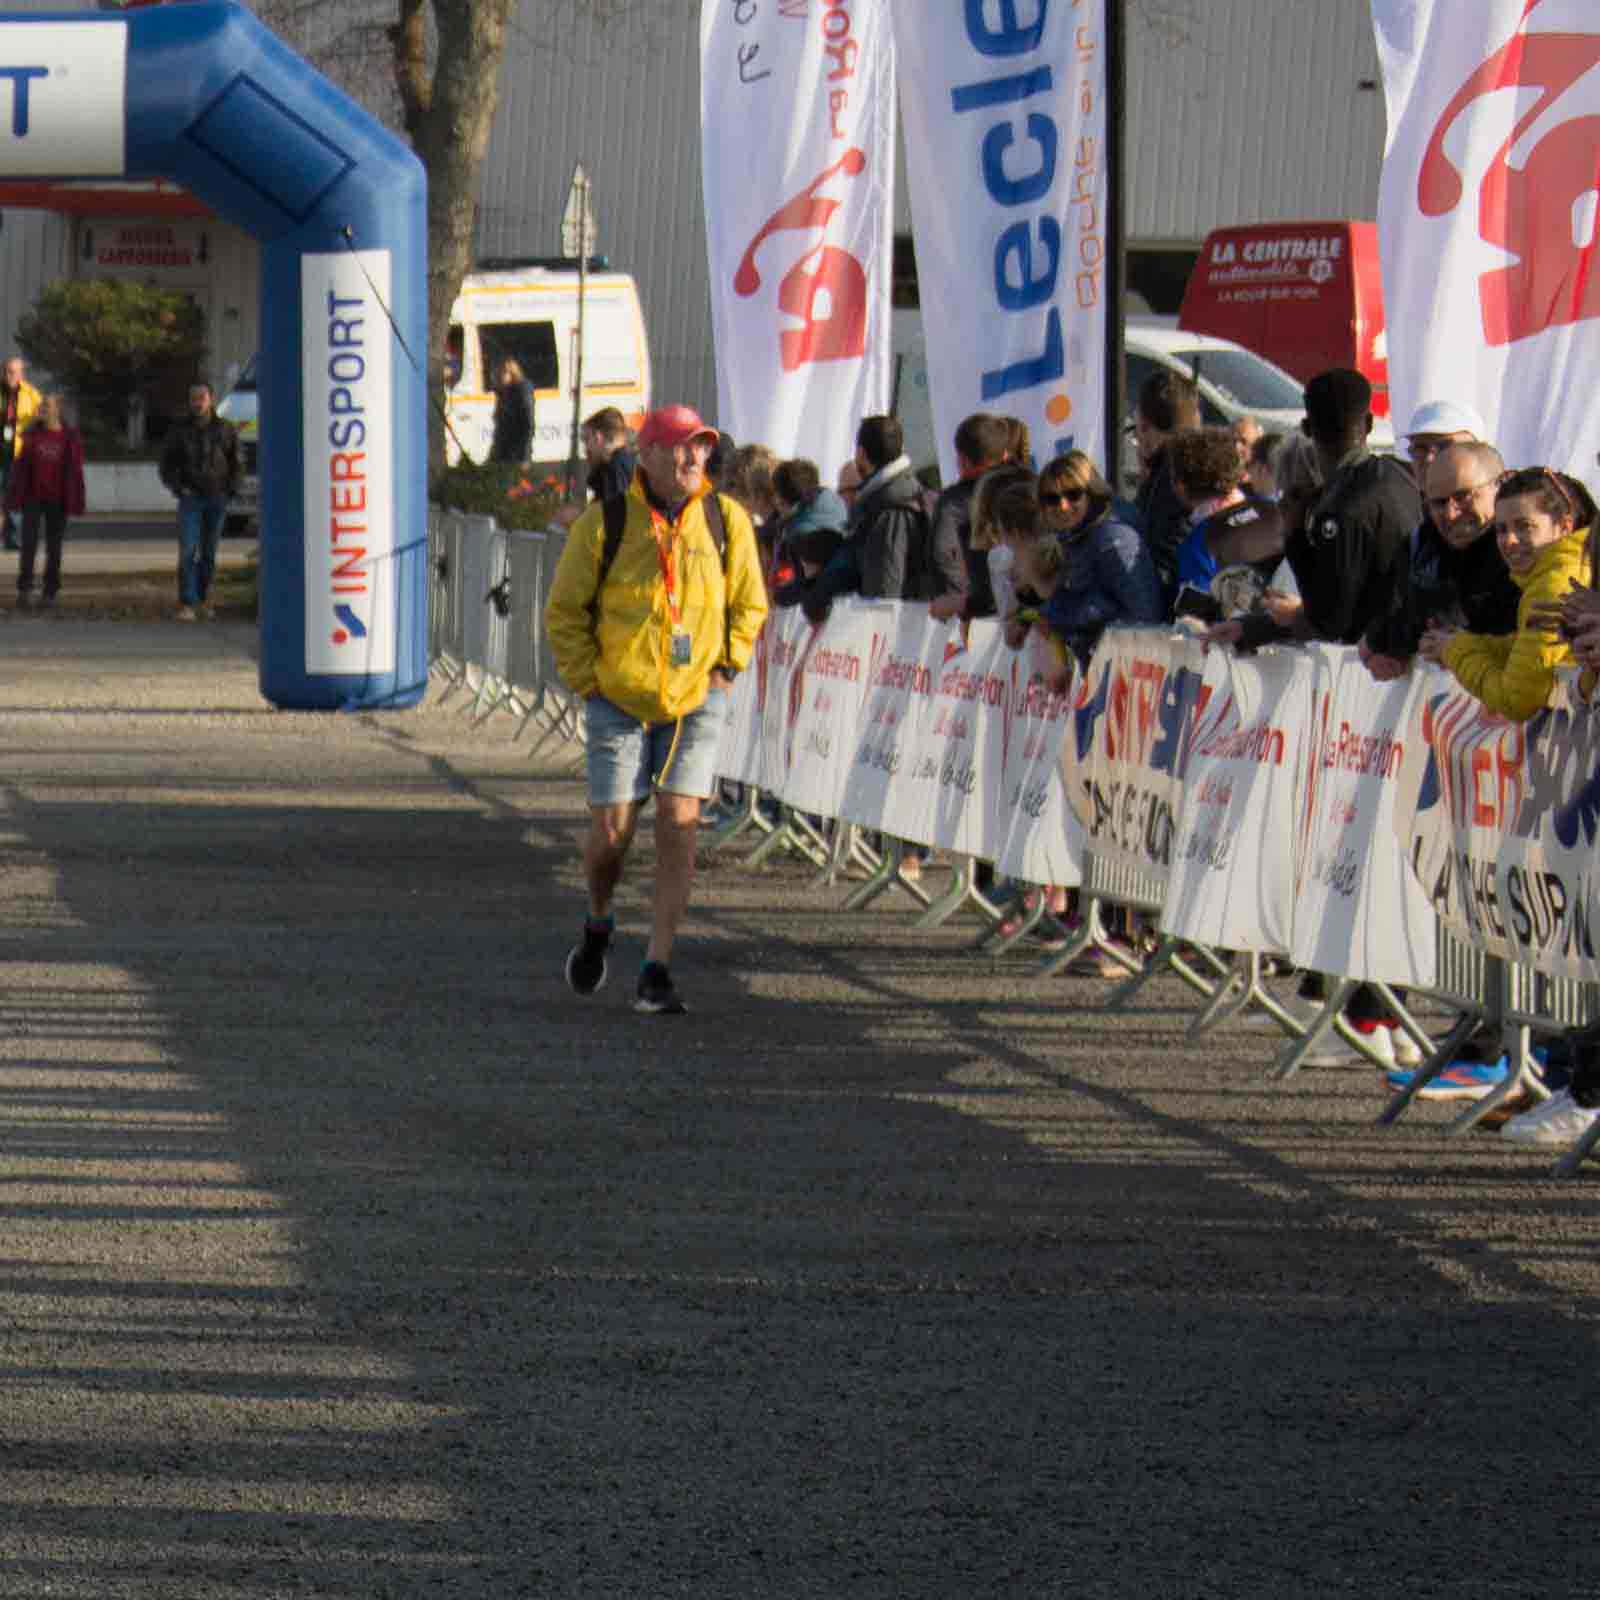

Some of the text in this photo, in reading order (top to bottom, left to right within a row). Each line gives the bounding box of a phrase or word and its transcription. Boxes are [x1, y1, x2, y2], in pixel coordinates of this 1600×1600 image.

[1211, 236, 1341, 263] LA CENTRALE
[328, 290, 367, 595] INTERSPORT
